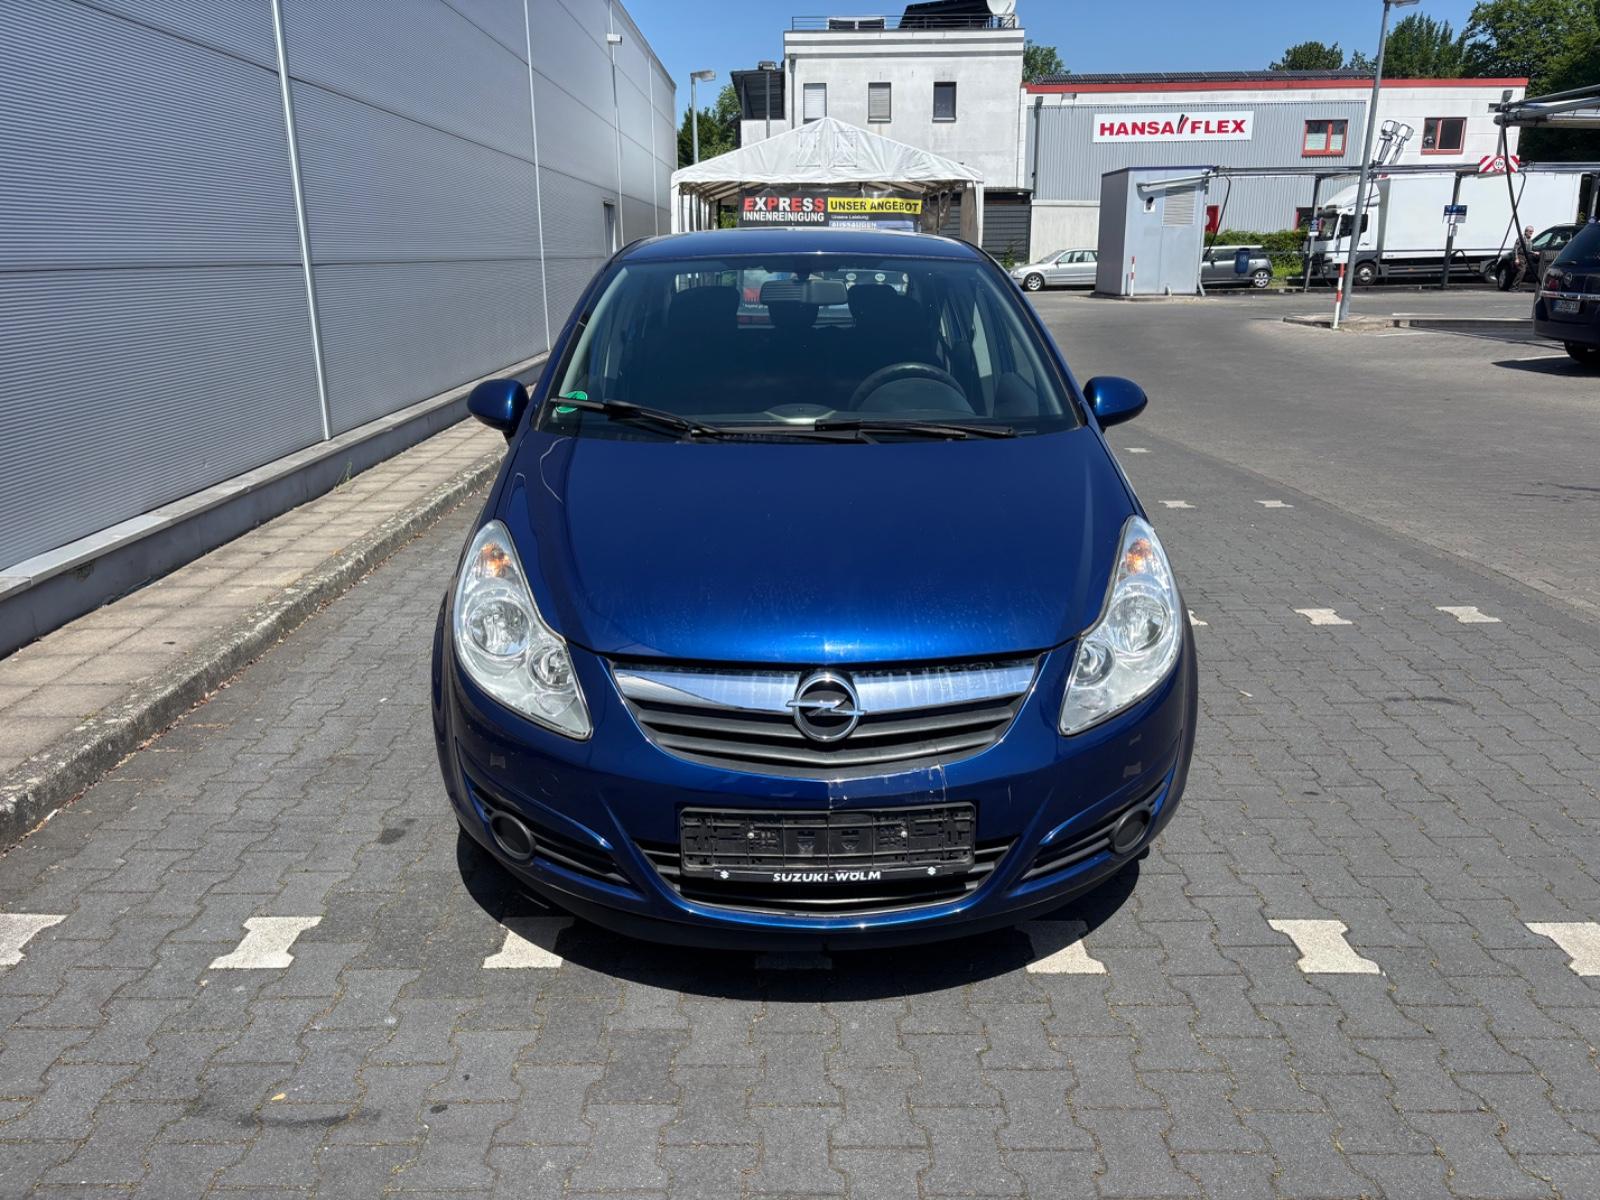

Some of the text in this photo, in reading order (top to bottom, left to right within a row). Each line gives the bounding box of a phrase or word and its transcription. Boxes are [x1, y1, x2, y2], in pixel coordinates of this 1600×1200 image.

[1099, 120, 1246, 136] HANSA FLEX
[744, 197, 825, 212] EXPRESS
[830, 200, 920, 213] UNSER ANGEBOT
[743, 211, 825, 222] INNENREINIGUNG
[773, 871, 881, 882] SUZUKI-WÖLM
